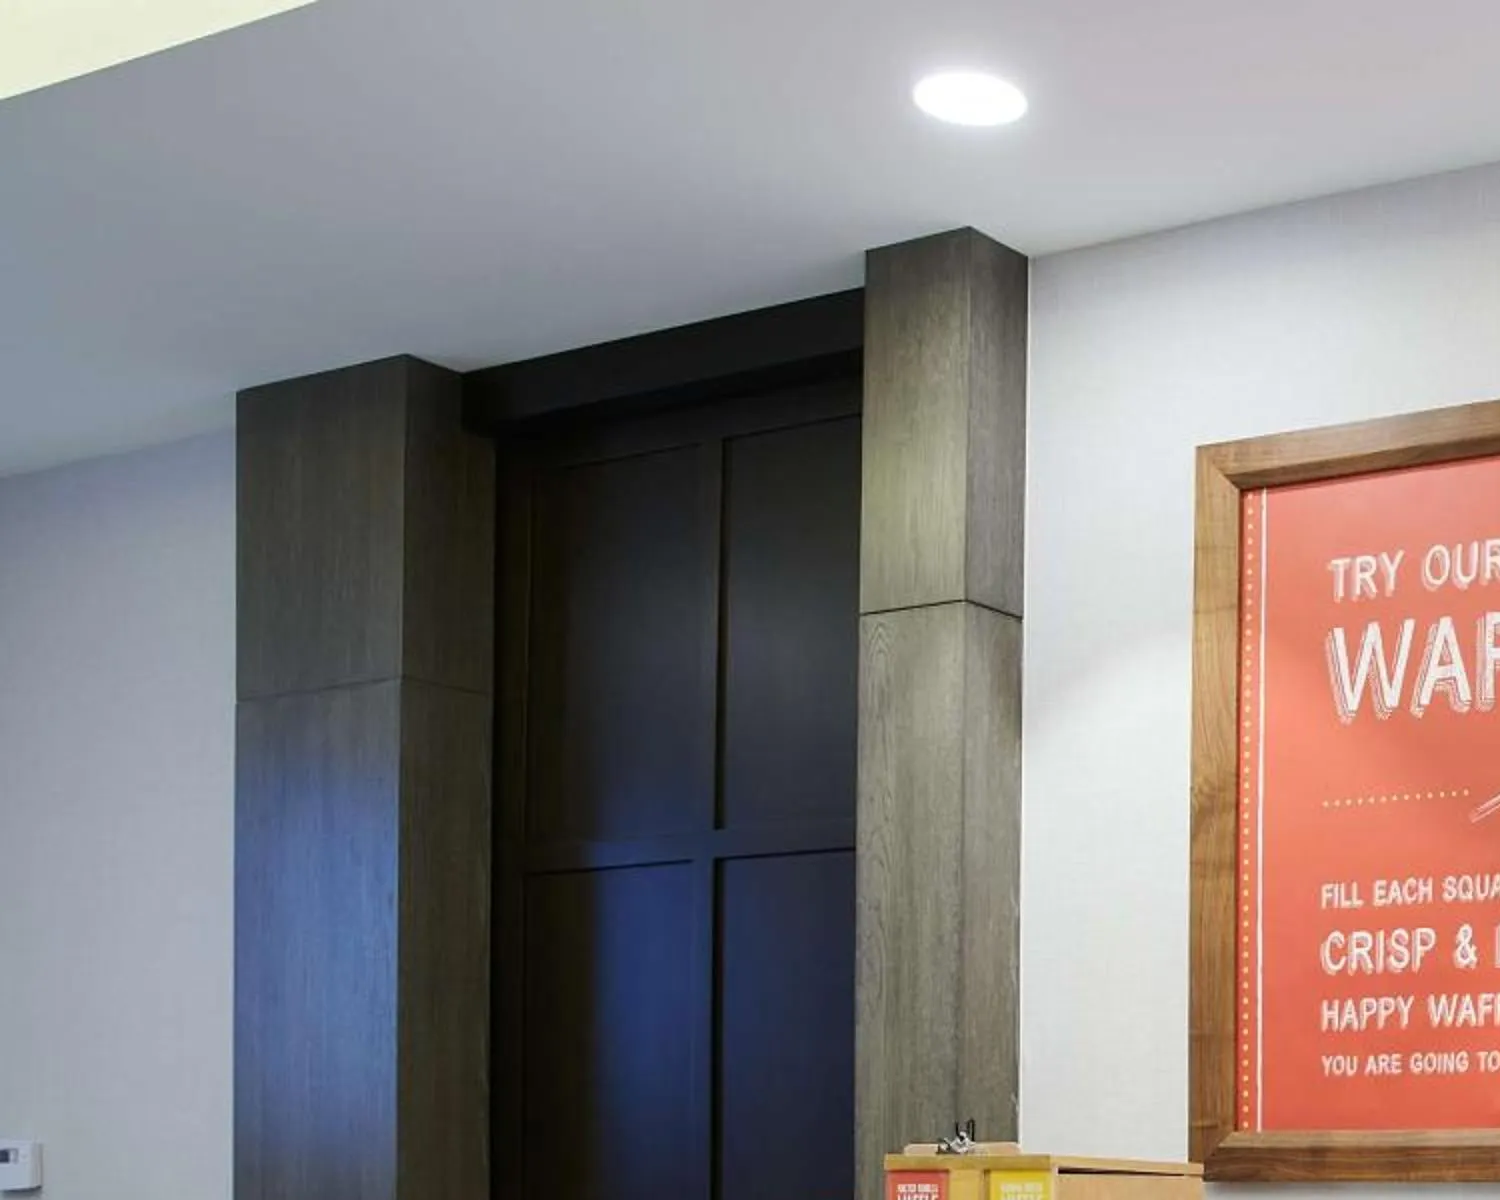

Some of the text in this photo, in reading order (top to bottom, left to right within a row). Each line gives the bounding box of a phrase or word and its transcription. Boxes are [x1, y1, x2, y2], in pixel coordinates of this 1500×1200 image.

[1328, 549, 1404, 604] TRY
[1321, 881, 1364, 909] FILL
[1373, 876, 1434, 906] EACH
[1320, 927, 1436, 976] CRISP
[1455, 923, 1478, 969] &
[1321, 995, 1414, 1032] HAPPY
[1321, 1054, 1358, 1077] YOU
[1364, 1053, 1402, 1077] ARE
[1410, 1051, 1469, 1074] GOING
[1477, 1051, 1500, 1073] TO
